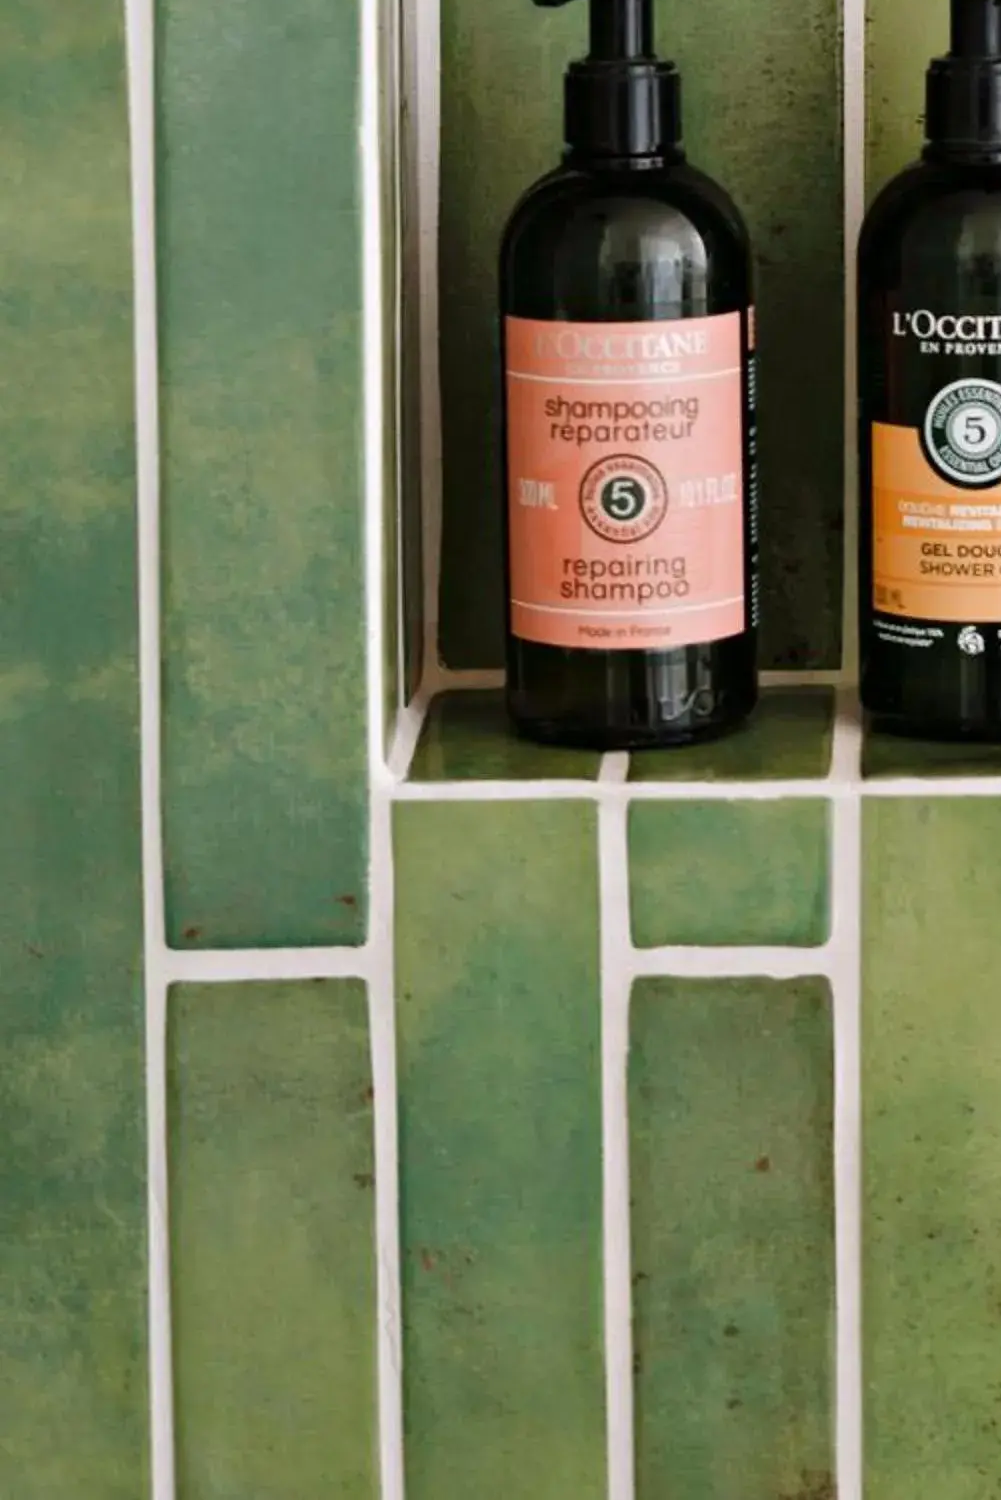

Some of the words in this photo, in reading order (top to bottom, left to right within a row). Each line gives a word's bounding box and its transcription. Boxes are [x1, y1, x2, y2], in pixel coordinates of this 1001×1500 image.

[920, 341, 940, 355] EN
[544, 395, 699, 421] shampooing
[964, 416, 987, 445] 5
[610, 481, 636, 516] 5
[921, 542, 952, 557] GEL
[562, 555, 686, 580] repairing
[920, 561, 995, 577] SHOWER
[560, 578, 690, 605] shampoo
